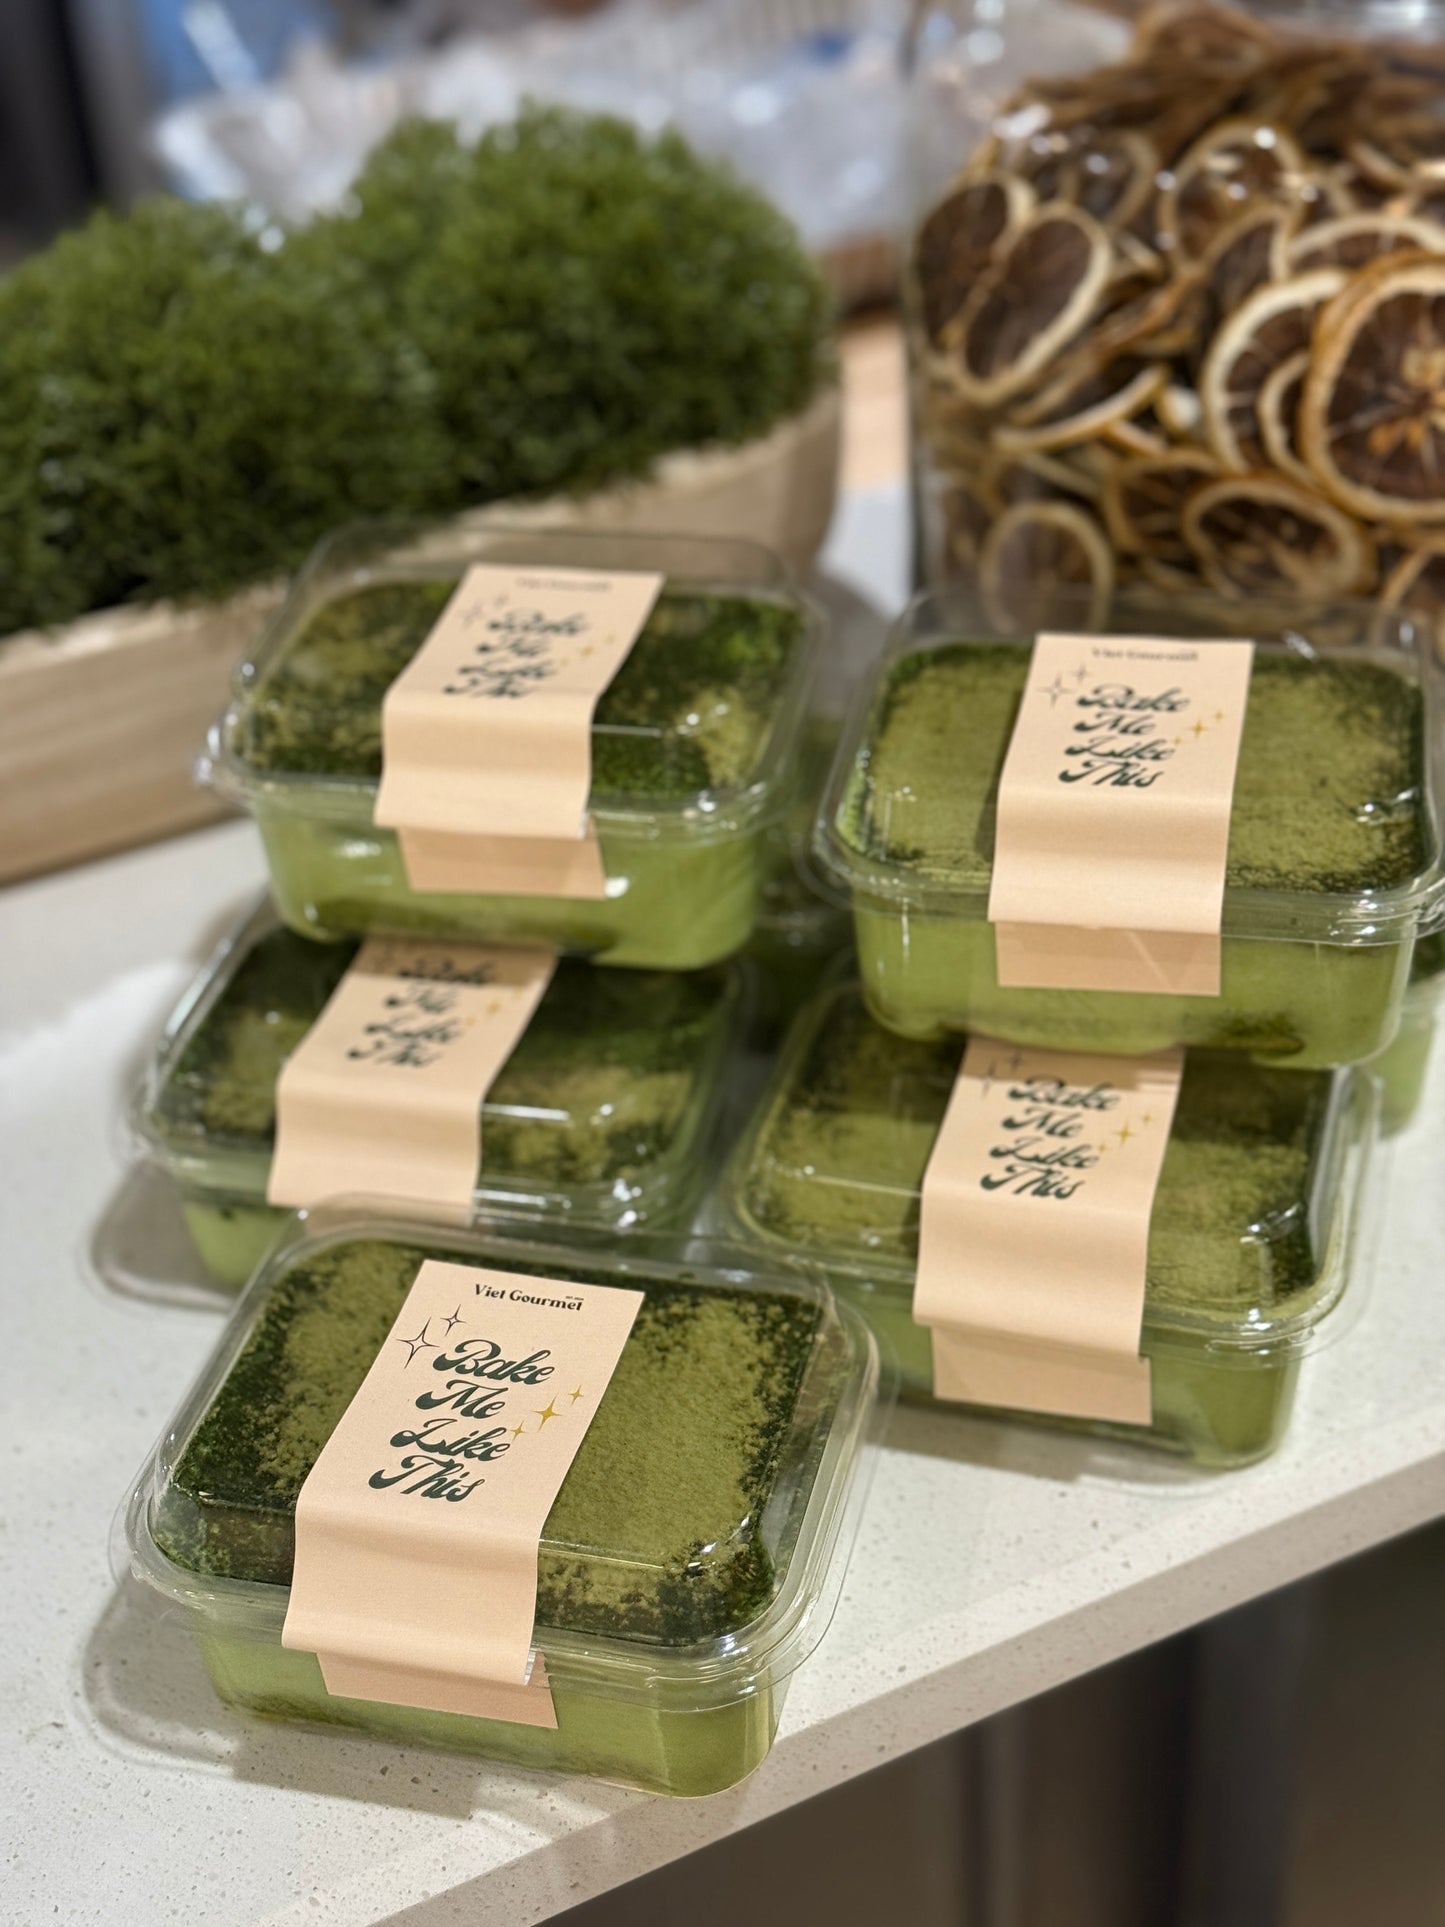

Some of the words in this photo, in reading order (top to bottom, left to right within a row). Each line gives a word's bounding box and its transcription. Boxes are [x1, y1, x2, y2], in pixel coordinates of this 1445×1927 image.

[1076, 683, 1191, 713] Bake
[1073, 711, 1157, 735] Me
[1064, 735, 1176, 761] Like
[1058, 759, 1164, 788] This
[1007, 1074, 1120, 1111] Bake
[1001, 1106, 1084, 1138] Me
[989, 1135, 1100, 1169] Like
[980, 1163, 1086, 1200] This
[475, 1283, 506, 1300] Viet
[509, 1288, 583, 1312] Gourmet
[432, 1339, 555, 1385] Bake
[415, 1379, 509, 1419] Me
[390, 1418, 511, 1462] Like
[368, 1454, 485, 1502] This
